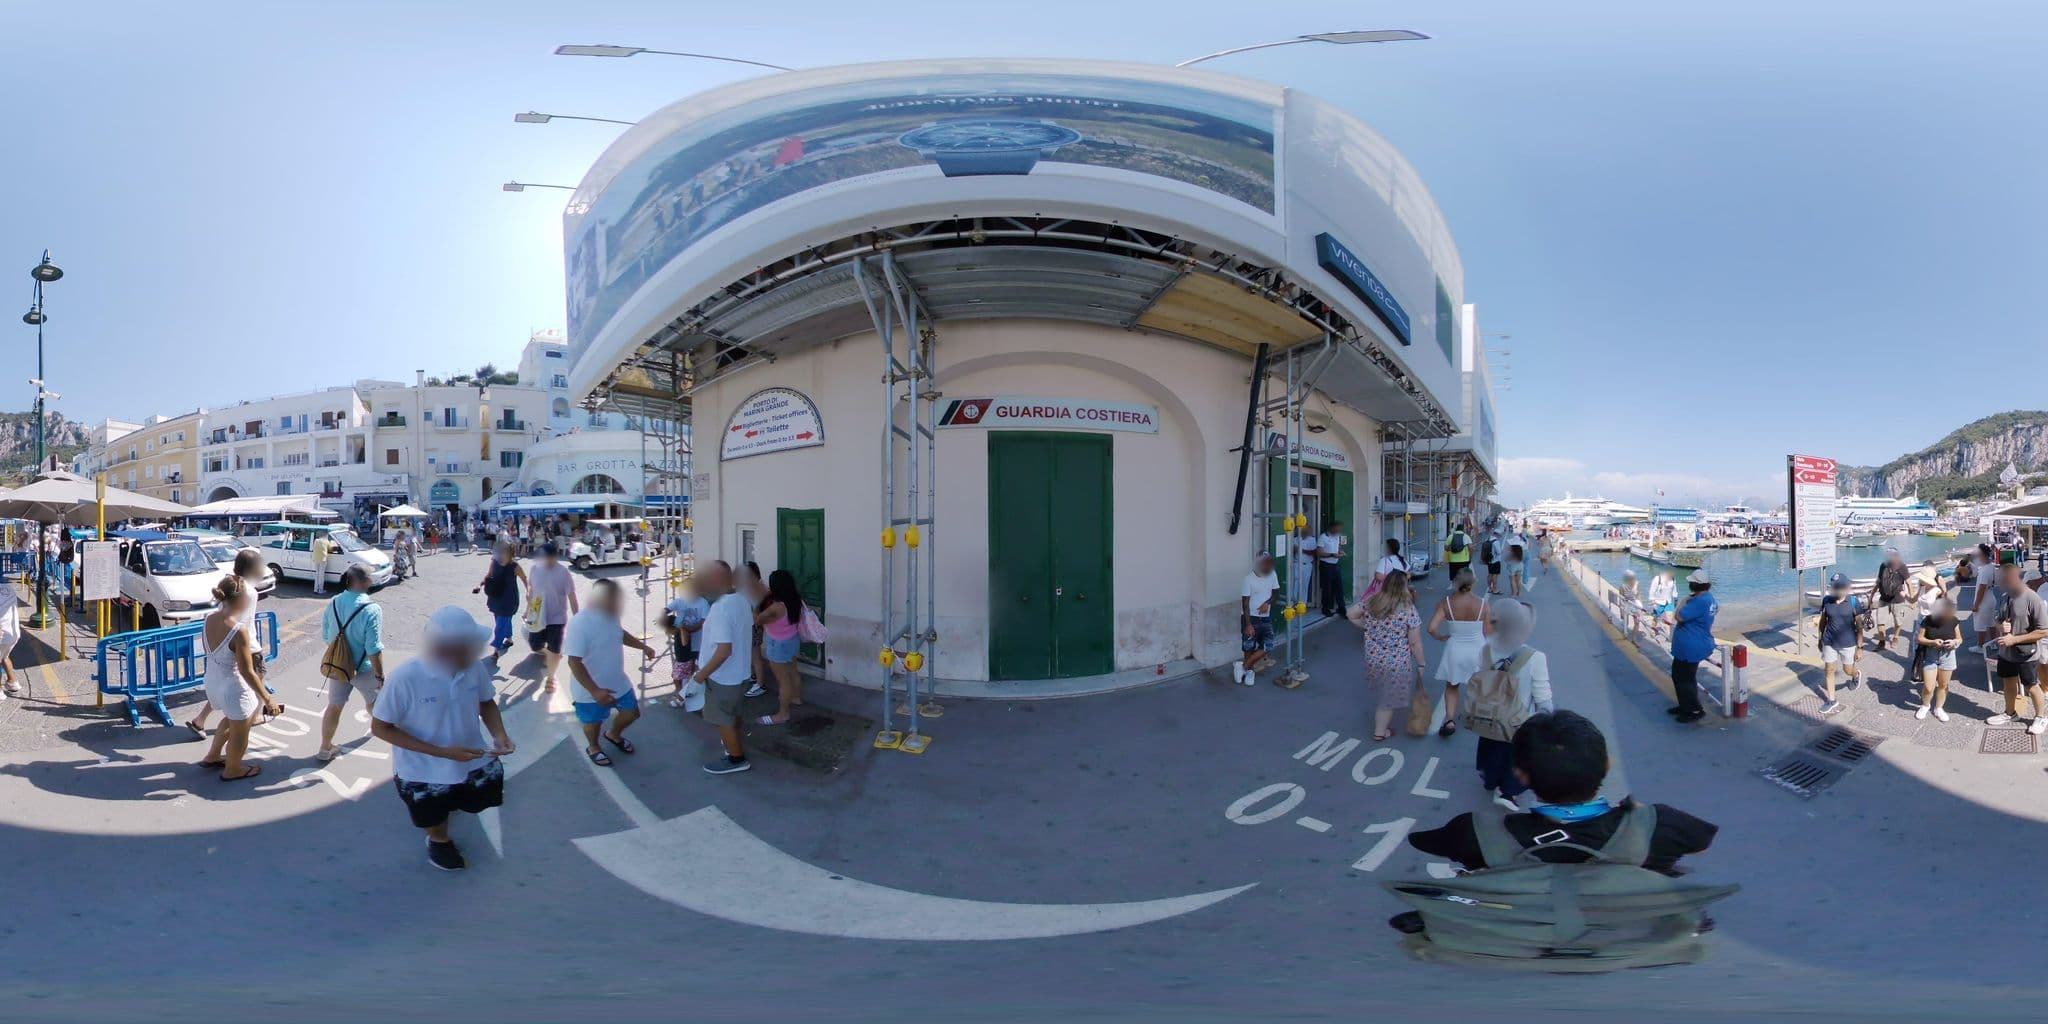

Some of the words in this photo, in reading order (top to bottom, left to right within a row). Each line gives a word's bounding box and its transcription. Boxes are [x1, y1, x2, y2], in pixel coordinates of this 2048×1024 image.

[743, 408, 764, 417] MARINA
[765, 400, 789, 412] GRANDE
[995, 405, 1072, 419] GUARDIA
[1075, 407, 1152, 425] COSTIERA
[766, 424, 789, 433] Toilette
[1291, 442, 1320, 456] GARDIA
[557, 463, 577, 473] BAR
[586, 460, 637, 471] GROTTA
